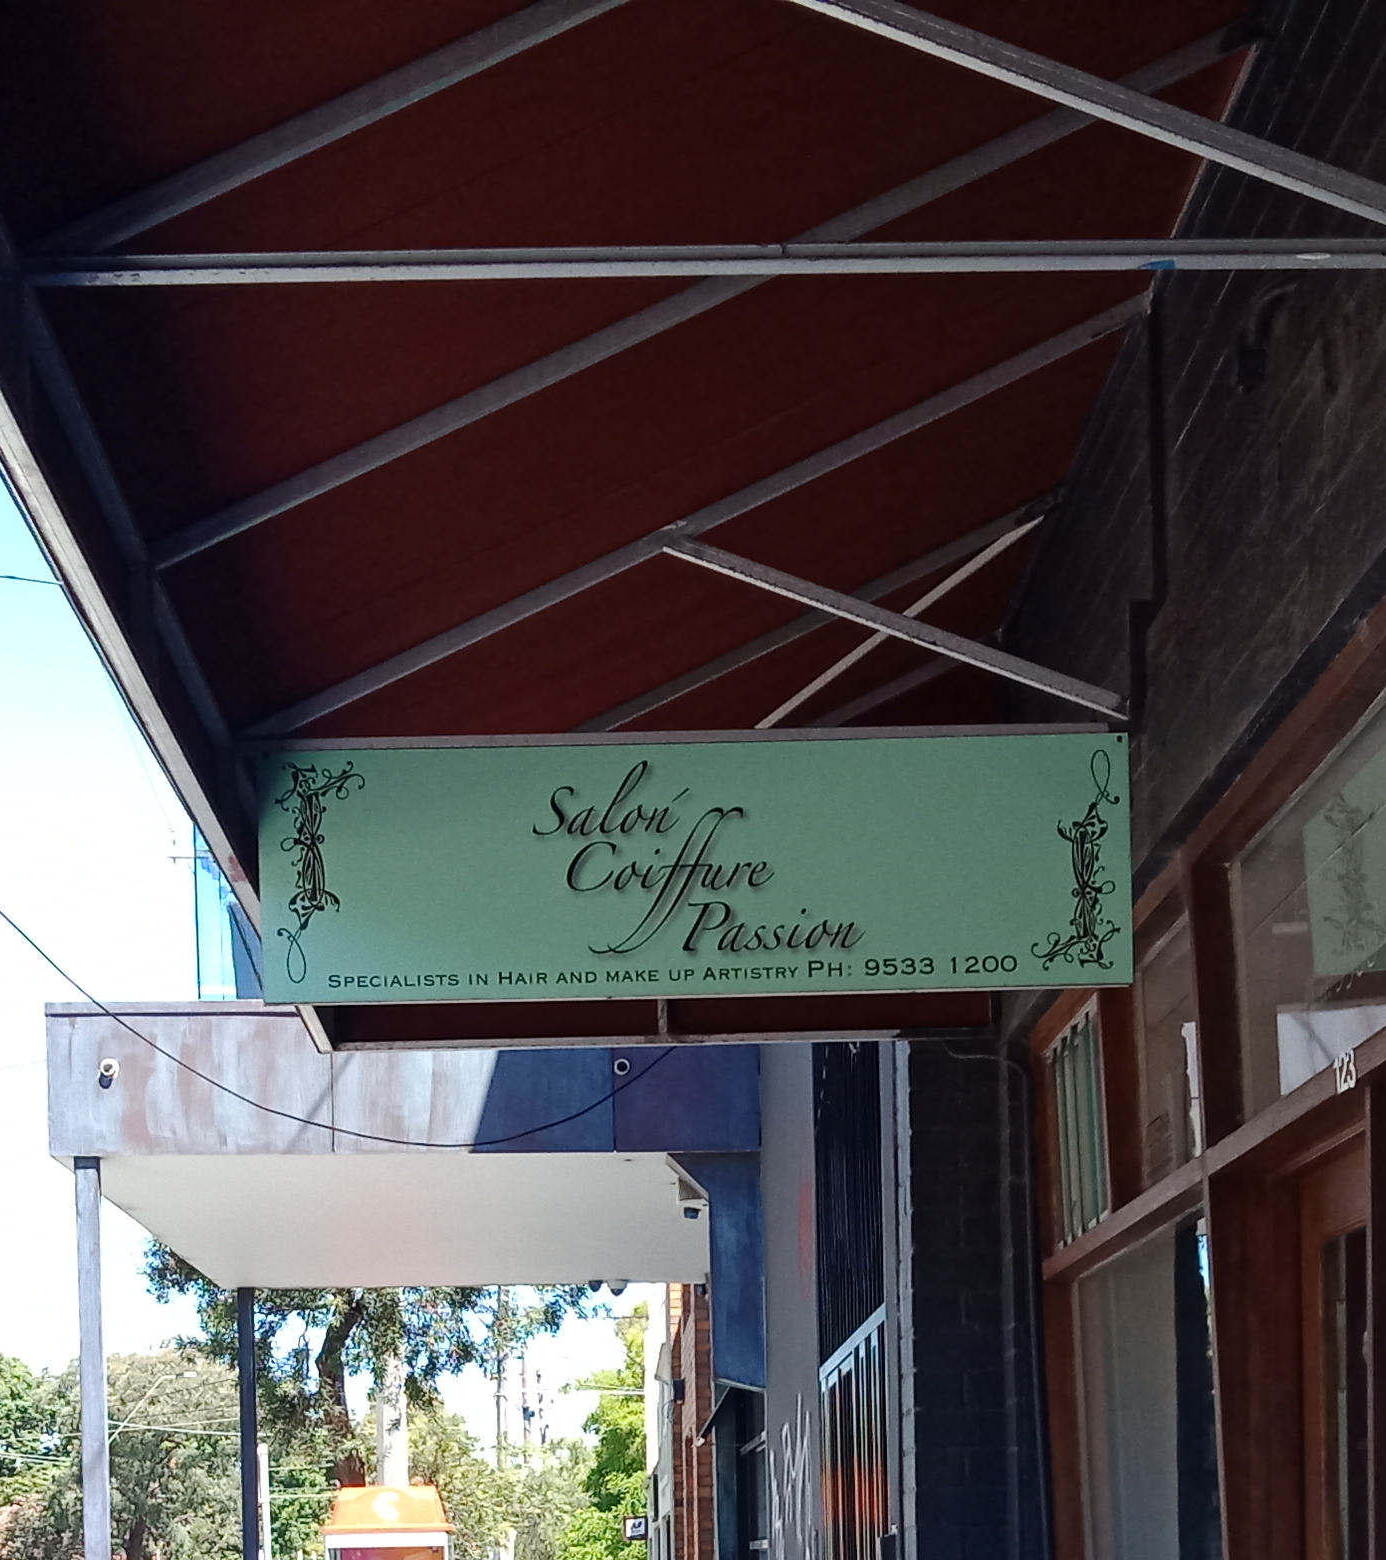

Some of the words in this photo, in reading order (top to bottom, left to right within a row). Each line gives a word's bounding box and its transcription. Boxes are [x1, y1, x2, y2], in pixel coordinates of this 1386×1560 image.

[566, 806, 775, 954] Coiffure
[681, 901, 865, 952] Passion
[864, 956, 936, 977] 9533
[950, 954, 1019, 975] 1200
[1332, 1048, 1358, 1095] 123
